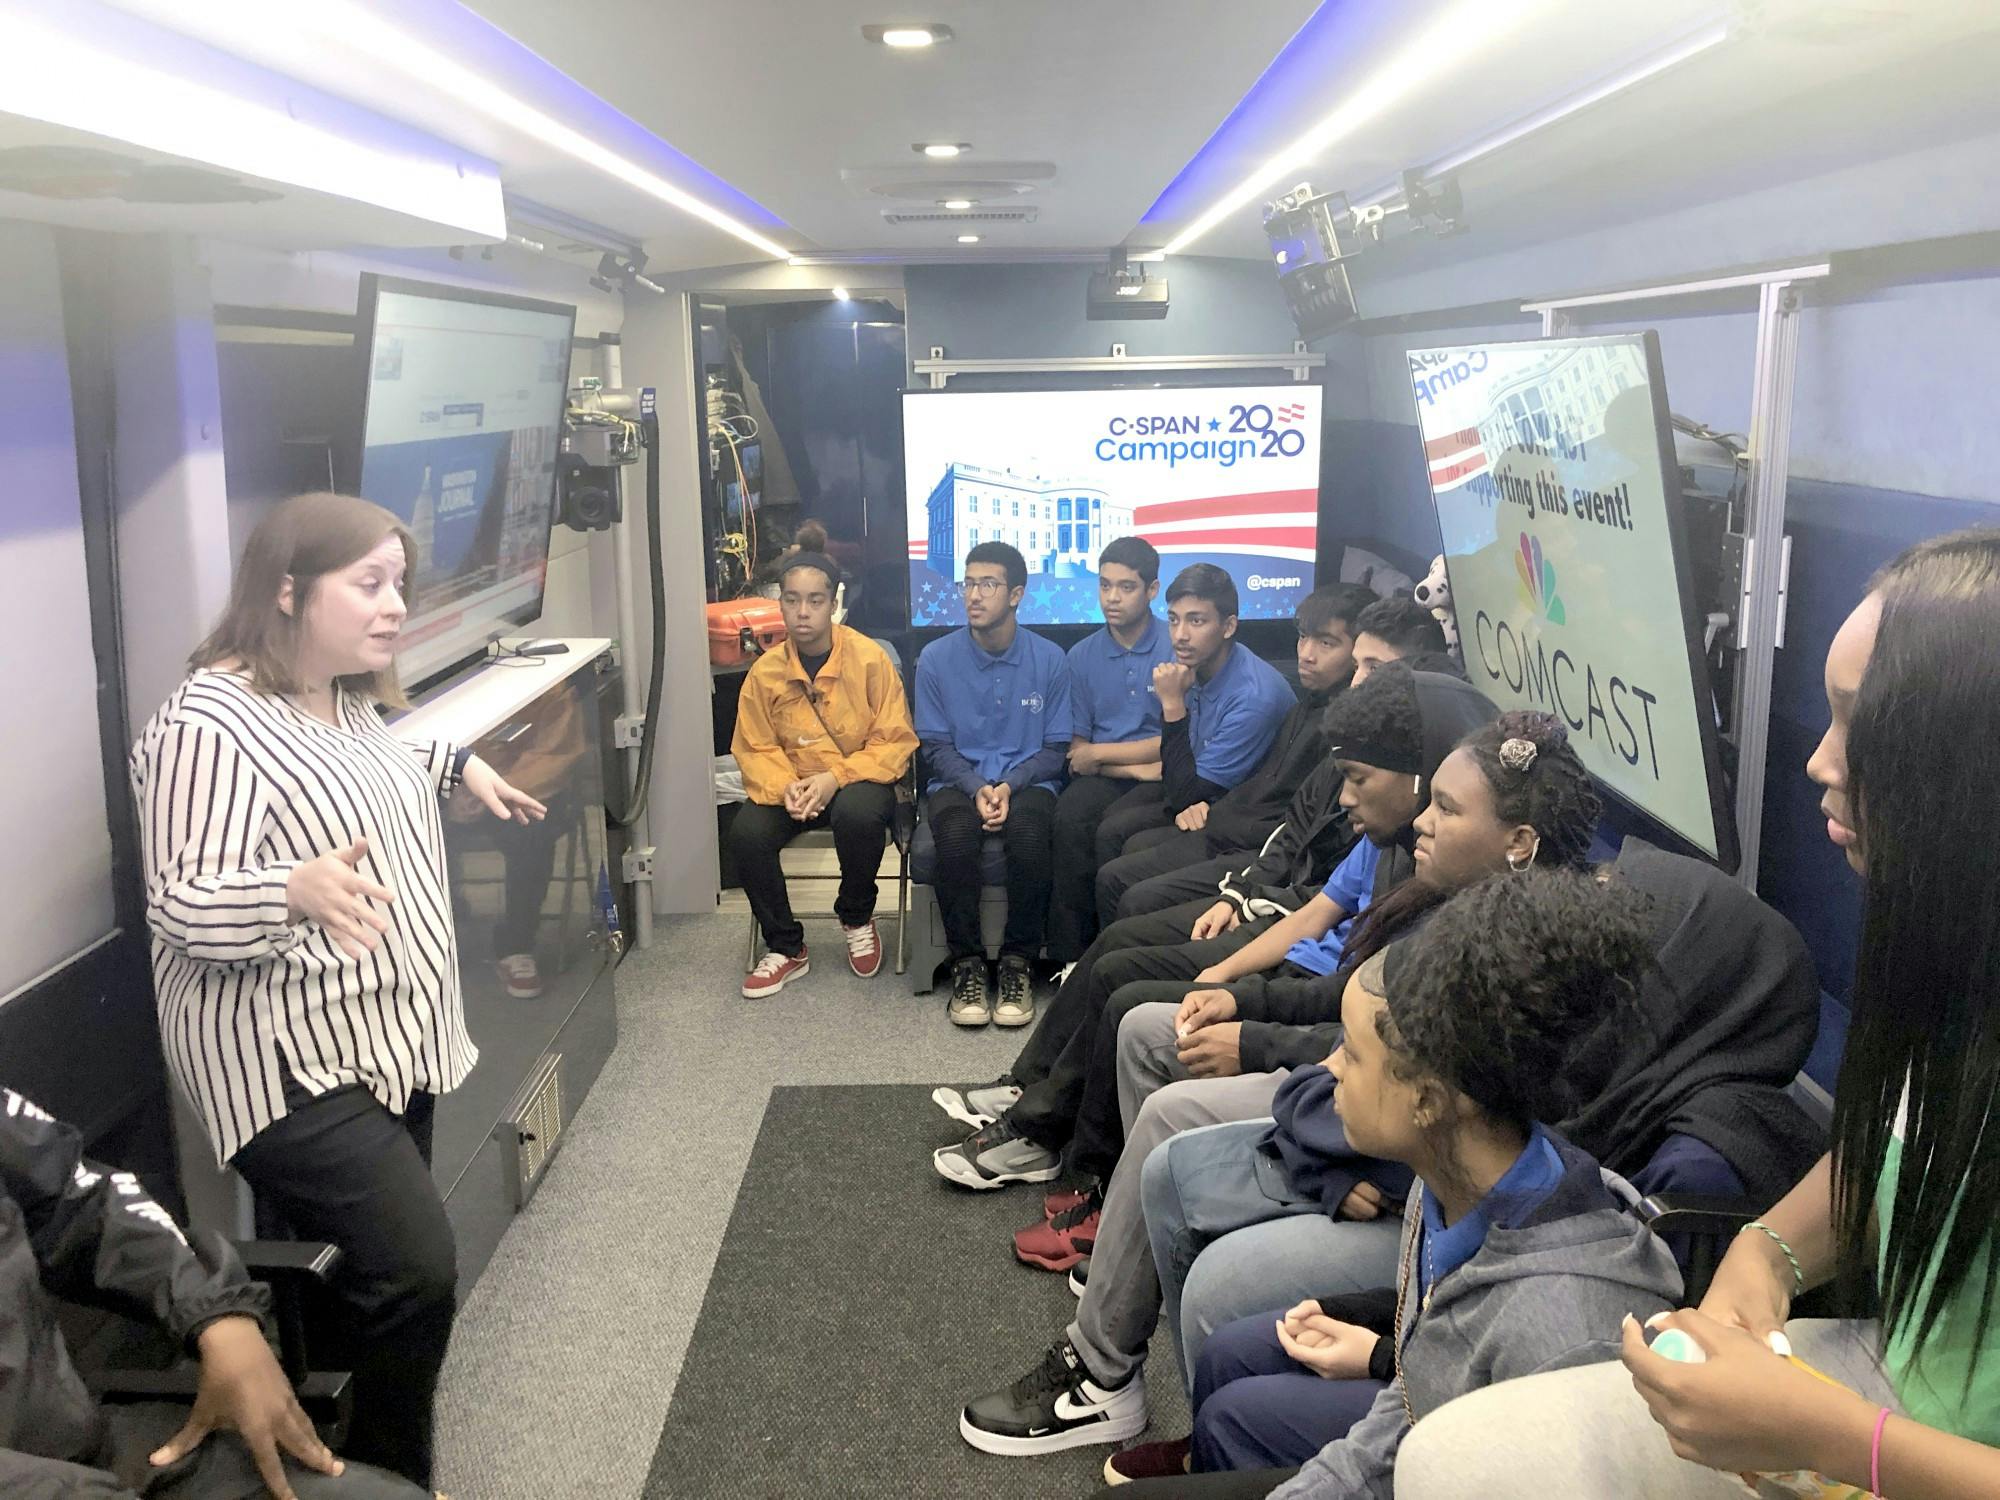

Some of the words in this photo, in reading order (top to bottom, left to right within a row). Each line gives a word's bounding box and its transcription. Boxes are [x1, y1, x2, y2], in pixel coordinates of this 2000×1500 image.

[1228, 404, 1273, 432] 20
[1095, 438, 1256, 468] Campaign
[1260, 429, 1305, 457] 20
[1536, 470, 1568, 516] this
[1573, 483, 1633, 531] event!
[1246, 574, 1301, 591] @cspan
[1476, 610, 1659, 780] COMCAST
